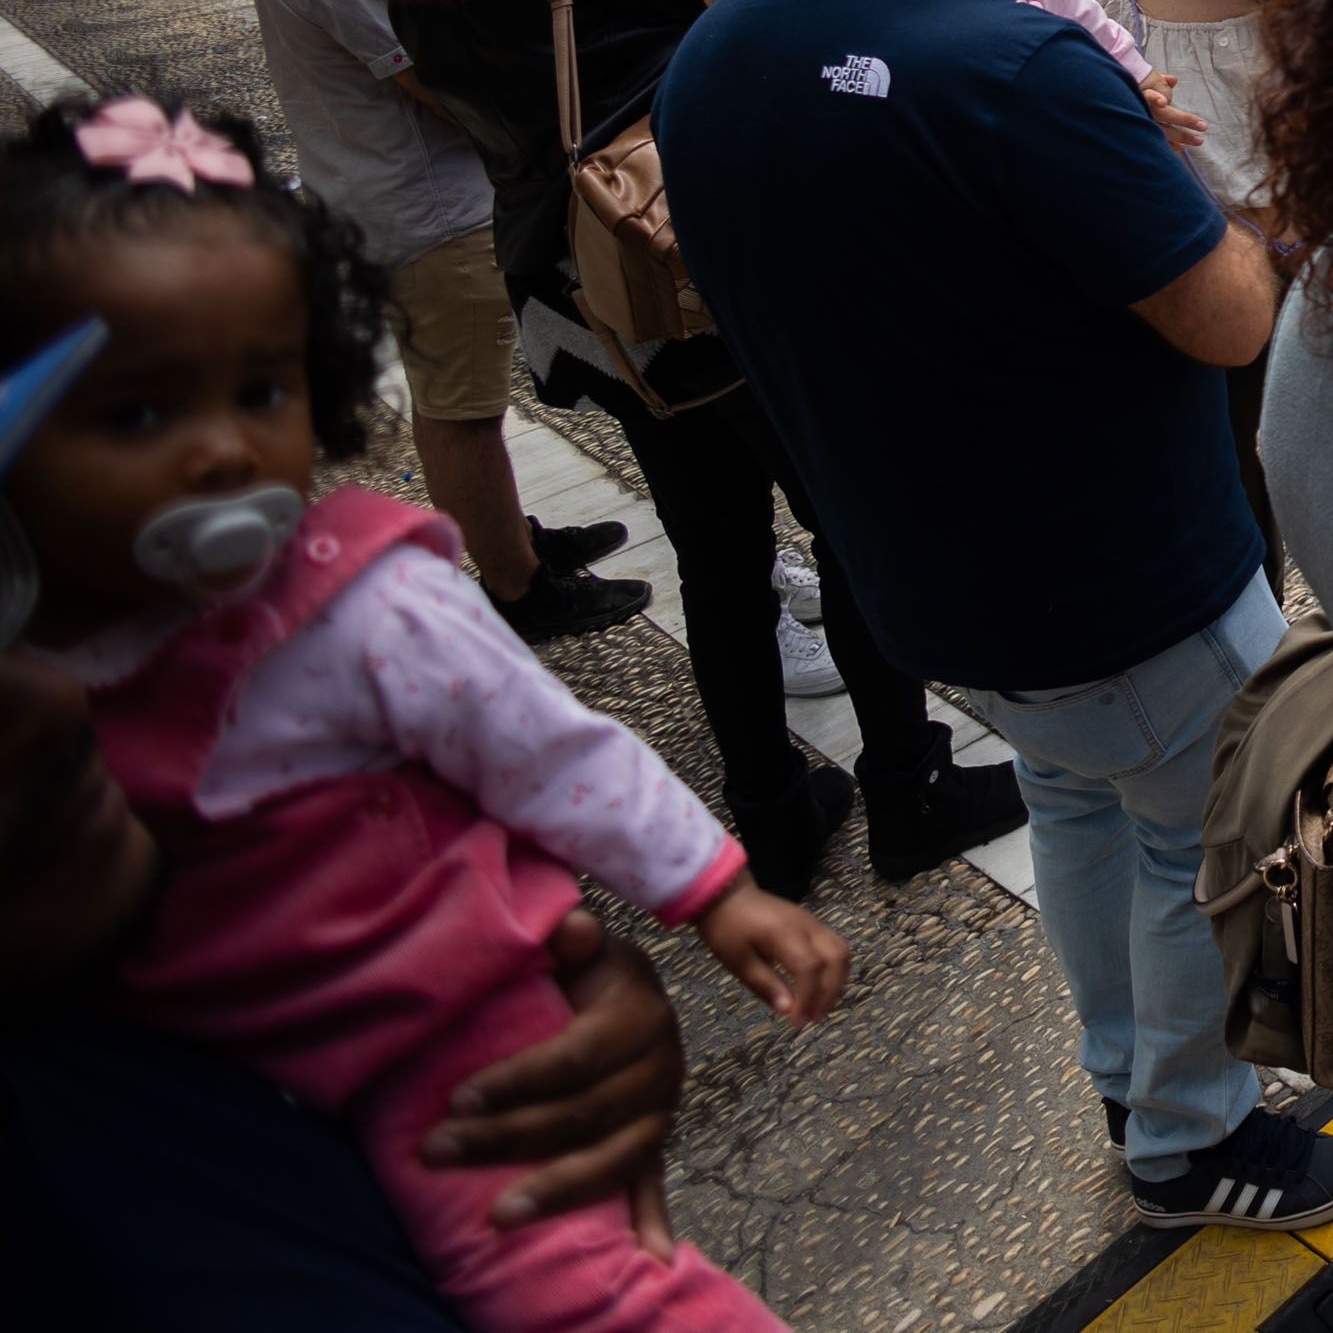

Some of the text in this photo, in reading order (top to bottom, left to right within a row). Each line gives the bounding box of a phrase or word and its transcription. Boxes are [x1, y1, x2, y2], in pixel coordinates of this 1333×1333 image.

[846, 54, 872, 69] THE
[821, 66, 867, 81] NORTH
[830, 78, 864, 94] FACE
